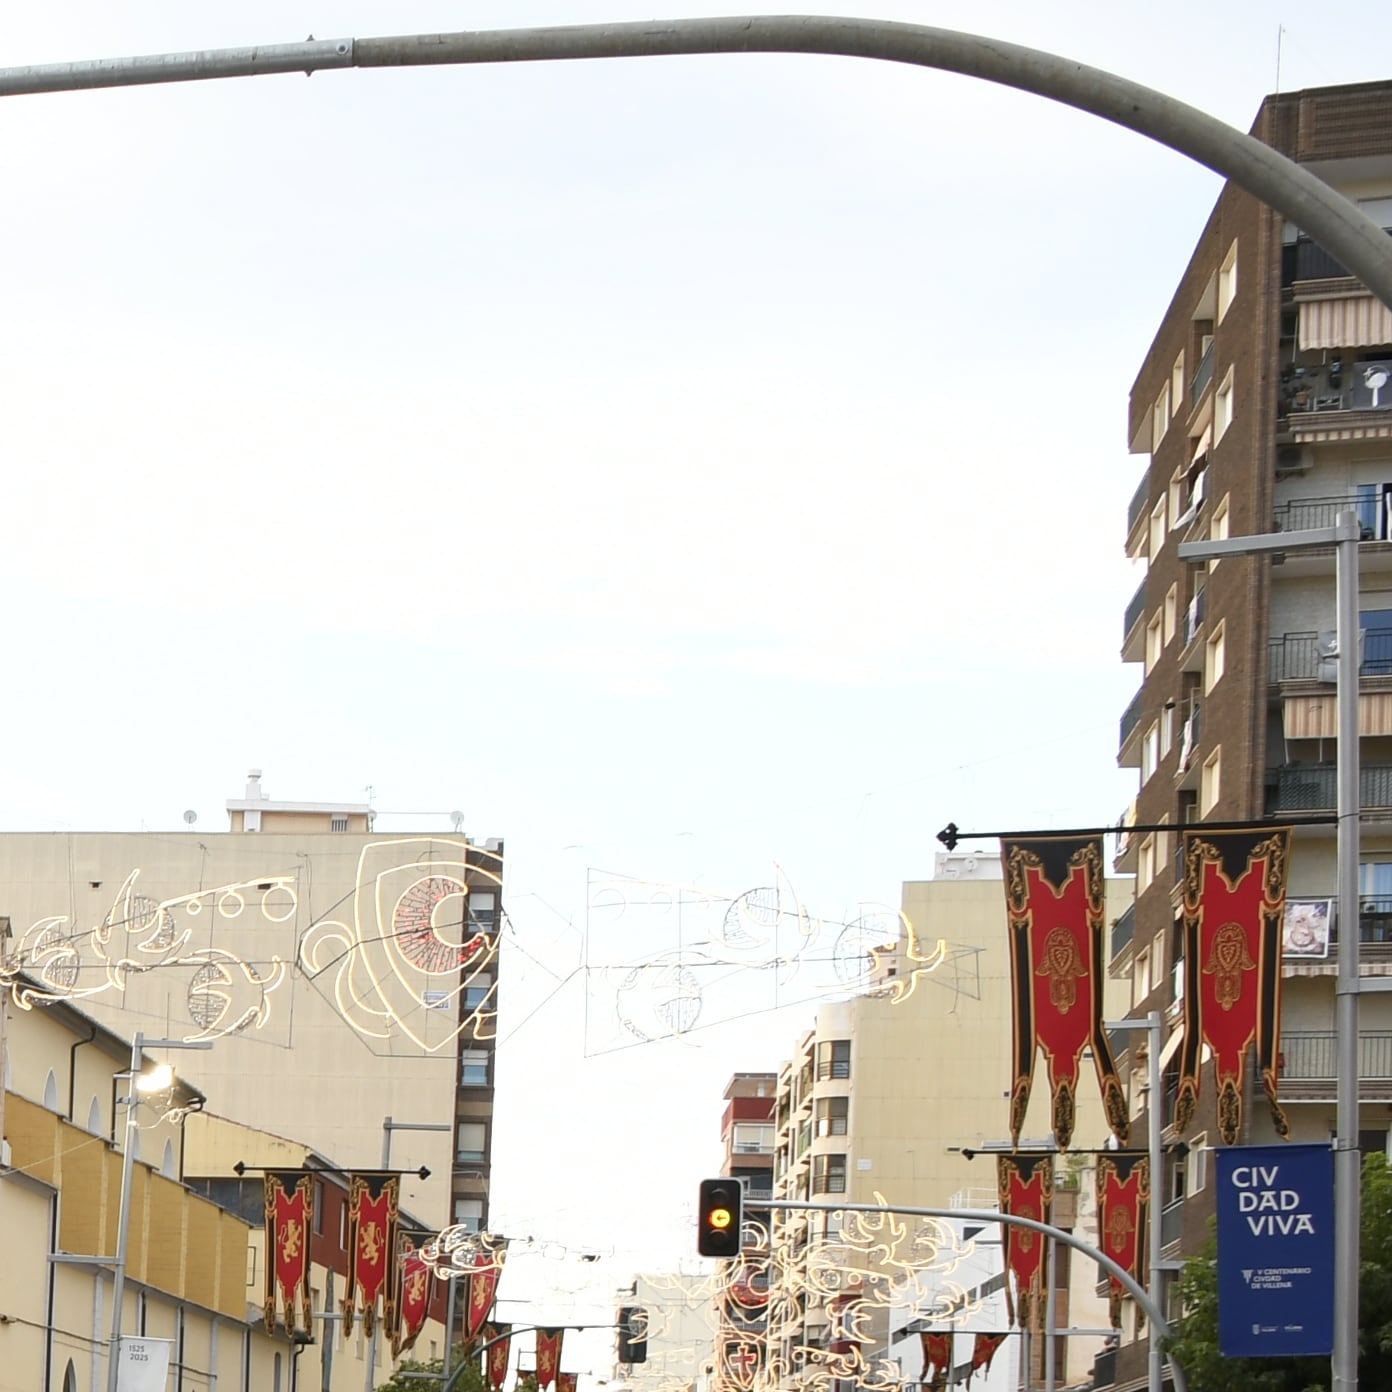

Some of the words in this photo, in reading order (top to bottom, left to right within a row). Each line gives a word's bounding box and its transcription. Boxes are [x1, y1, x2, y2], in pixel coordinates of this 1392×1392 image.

[1231, 1166, 1279, 1188] CIV
[1239, 1190, 1300, 1212] DAD
[1246, 1213, 1315, 1237] VIVA
[128, 1344, 145, 1353] 1525
[130, 1353, 149, 1361] 2025
